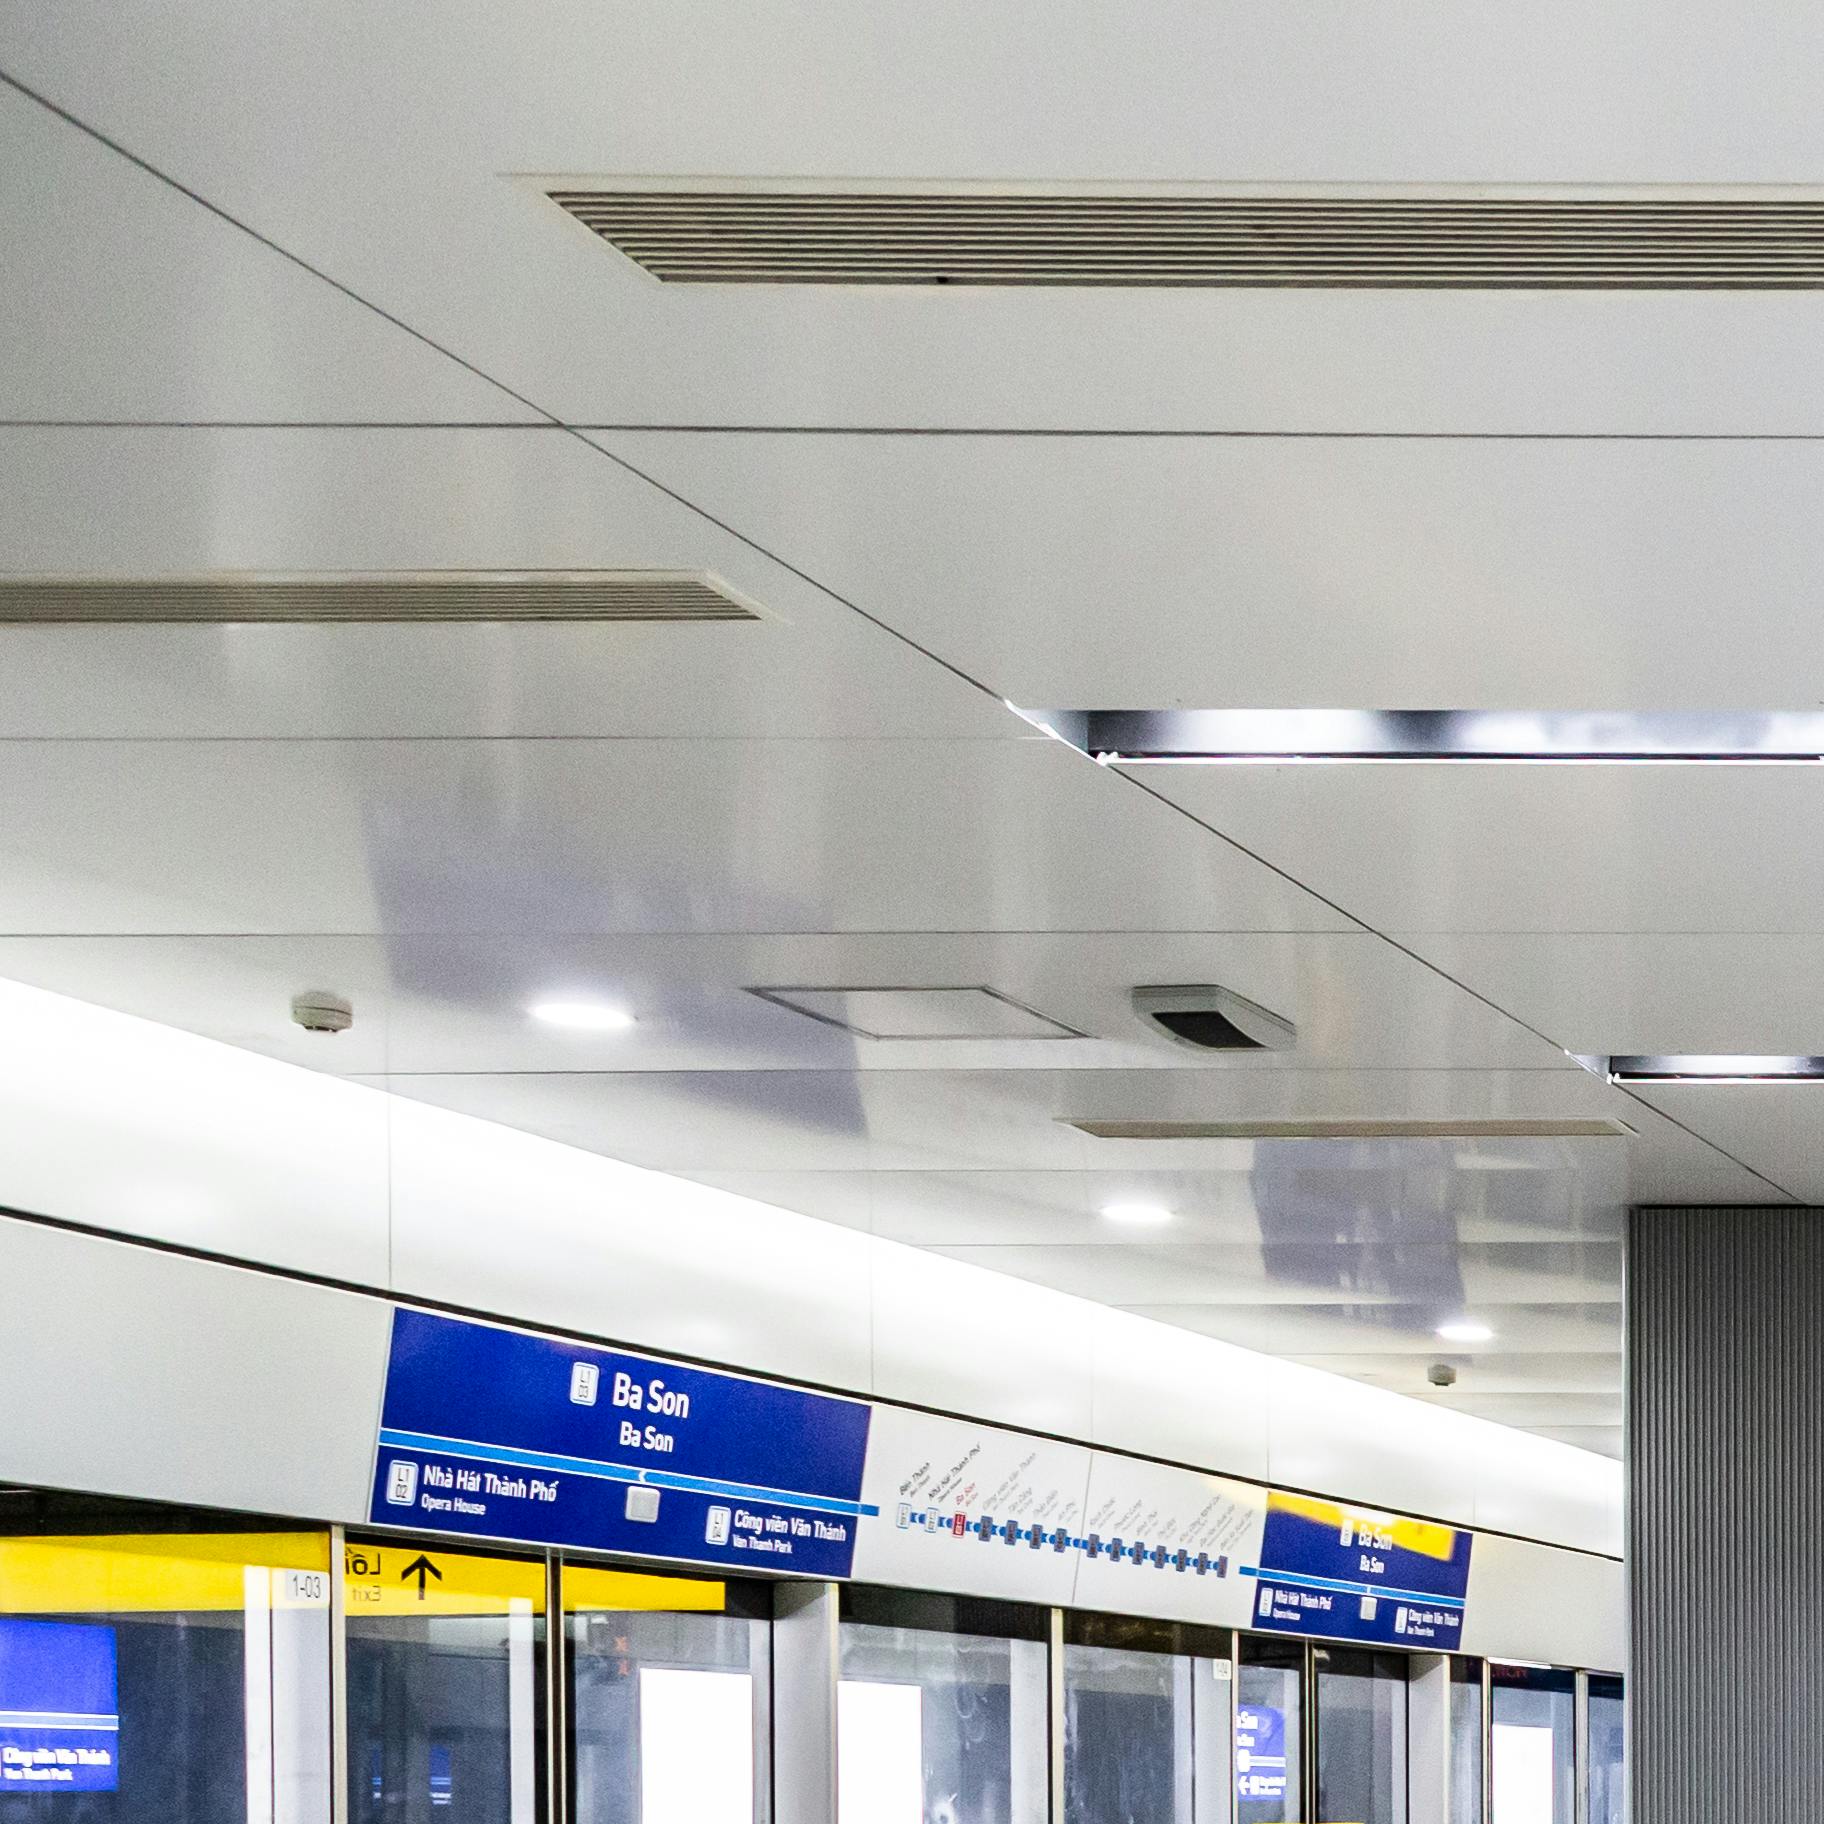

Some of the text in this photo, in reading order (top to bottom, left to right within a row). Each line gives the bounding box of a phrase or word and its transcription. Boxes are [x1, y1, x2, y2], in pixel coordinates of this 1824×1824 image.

[612, 1372, 690, 1419] Ba Son
[619, 1421, 674, 1453] Ba Son
[423, 1464, 560, 1502] Nhà Hát Thành Phố
[421, 1493, 487, 1516] Opera House
[734, 1509, 763, 1535] Công
[765, 1514, 789, 1534] viên
[813, 1519, 847, 1542] Thánh
[1358, 1524, 1392, 1551] Ba Son
[774, 1538, 793, 1554] Park
[1359, 1554, 1385, 1574] Ba Son
[292, 1574, 321, 1599] 1-03
